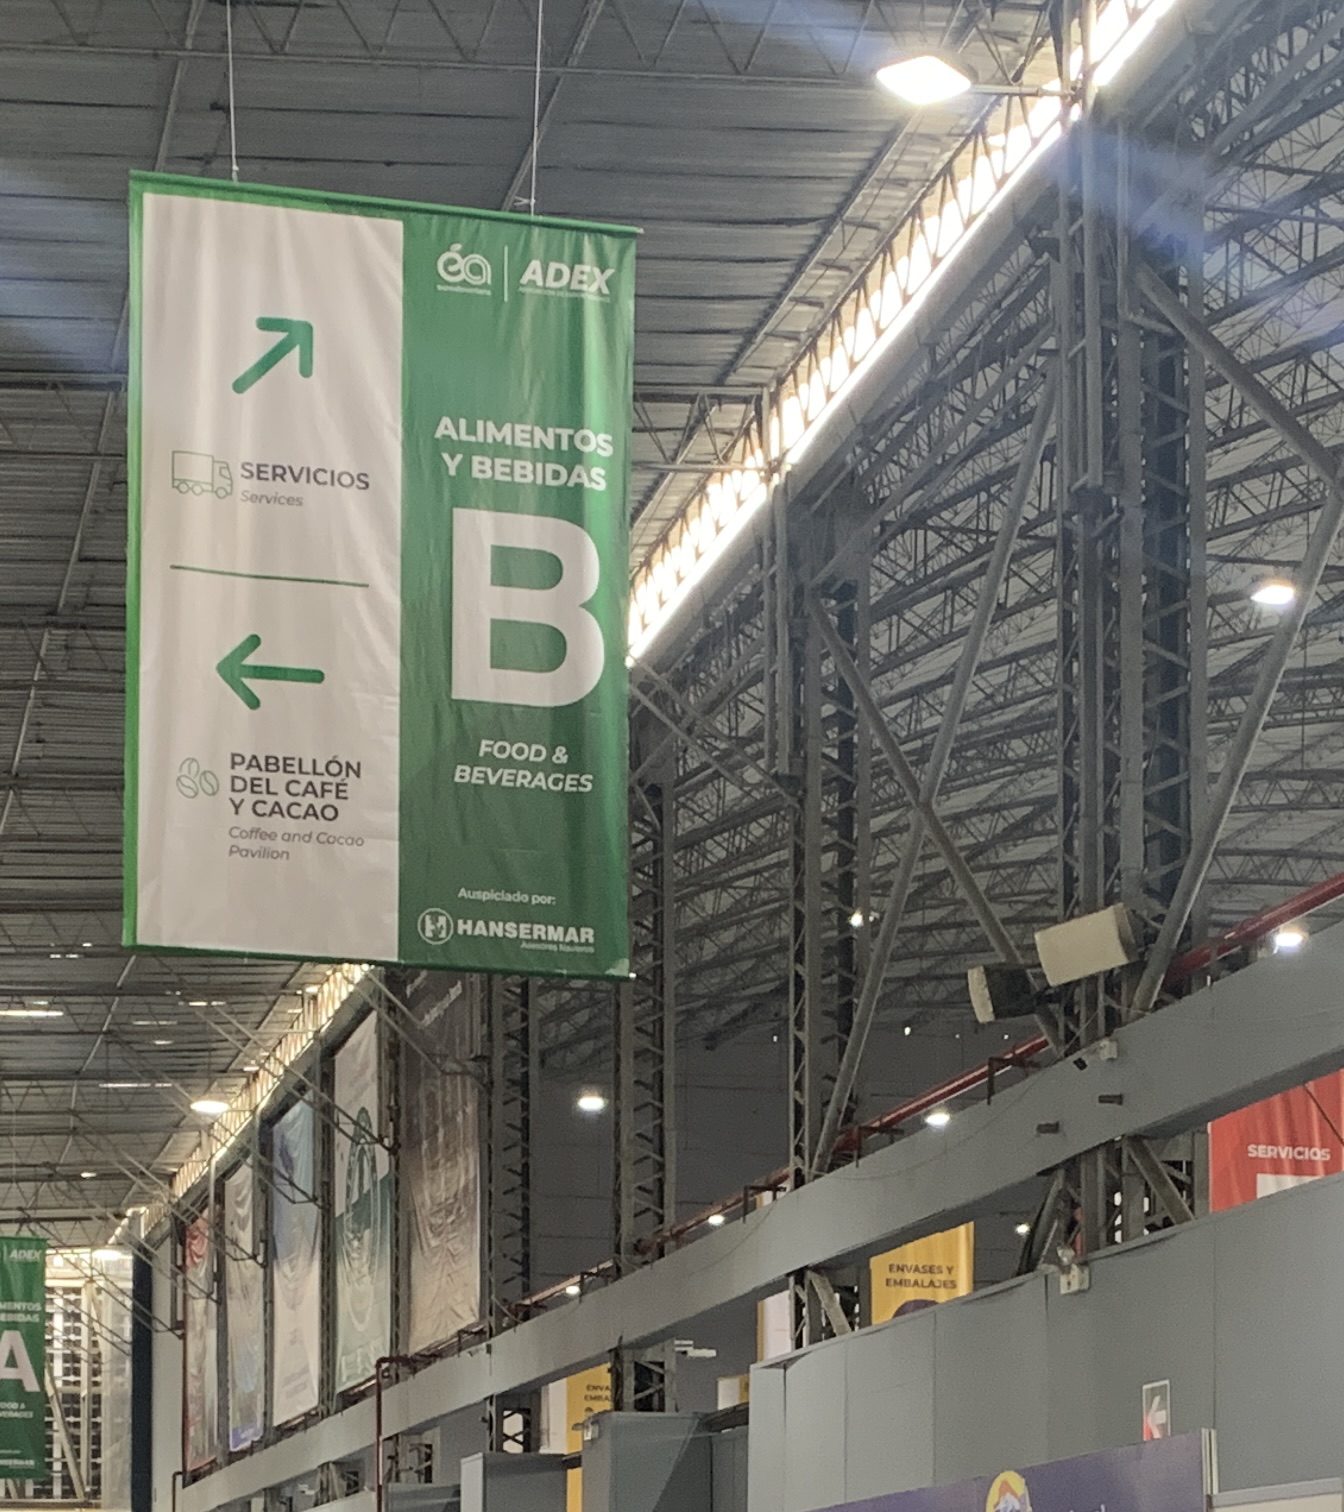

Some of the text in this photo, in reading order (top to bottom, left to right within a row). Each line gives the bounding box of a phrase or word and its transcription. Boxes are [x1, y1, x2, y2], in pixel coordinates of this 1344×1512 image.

[520, 260, 615, 295] ADEX
[434, 416, 614, 457] ALIMENTOS
[240, 462, 370, 490] SERVICIOS
[441, 453, 606, 491] Y BEBIDAS
[240, 490, 304, 506] Services
[451, 507, 605, 707] B
[479, 739, 568, 764] FOOD &
[230, 753, 361, 779] PABELLÓN
[230, 775, 349, 800] DEL CAFÉ
[454, 765, 594, 793] BEVERAGES
[229, 798, 339, 821] Y CACAO
[228, 826, 278, 841] Coffee
[281, 830, 313, 844] and
[228, 845, 290, 860] Pavilion
[458, 887, 556, 906] Auspiciado por:
[457, 919, 595, 944] HANSERMAR
[1247, 1144, 1331, 1160] SERVICIOS
[9, 1250, 42, 1260] ADEX
[888, 1263, 955, 1275] ENVASES Y
[885, 1278, 957, 1289] EMBALAJES
